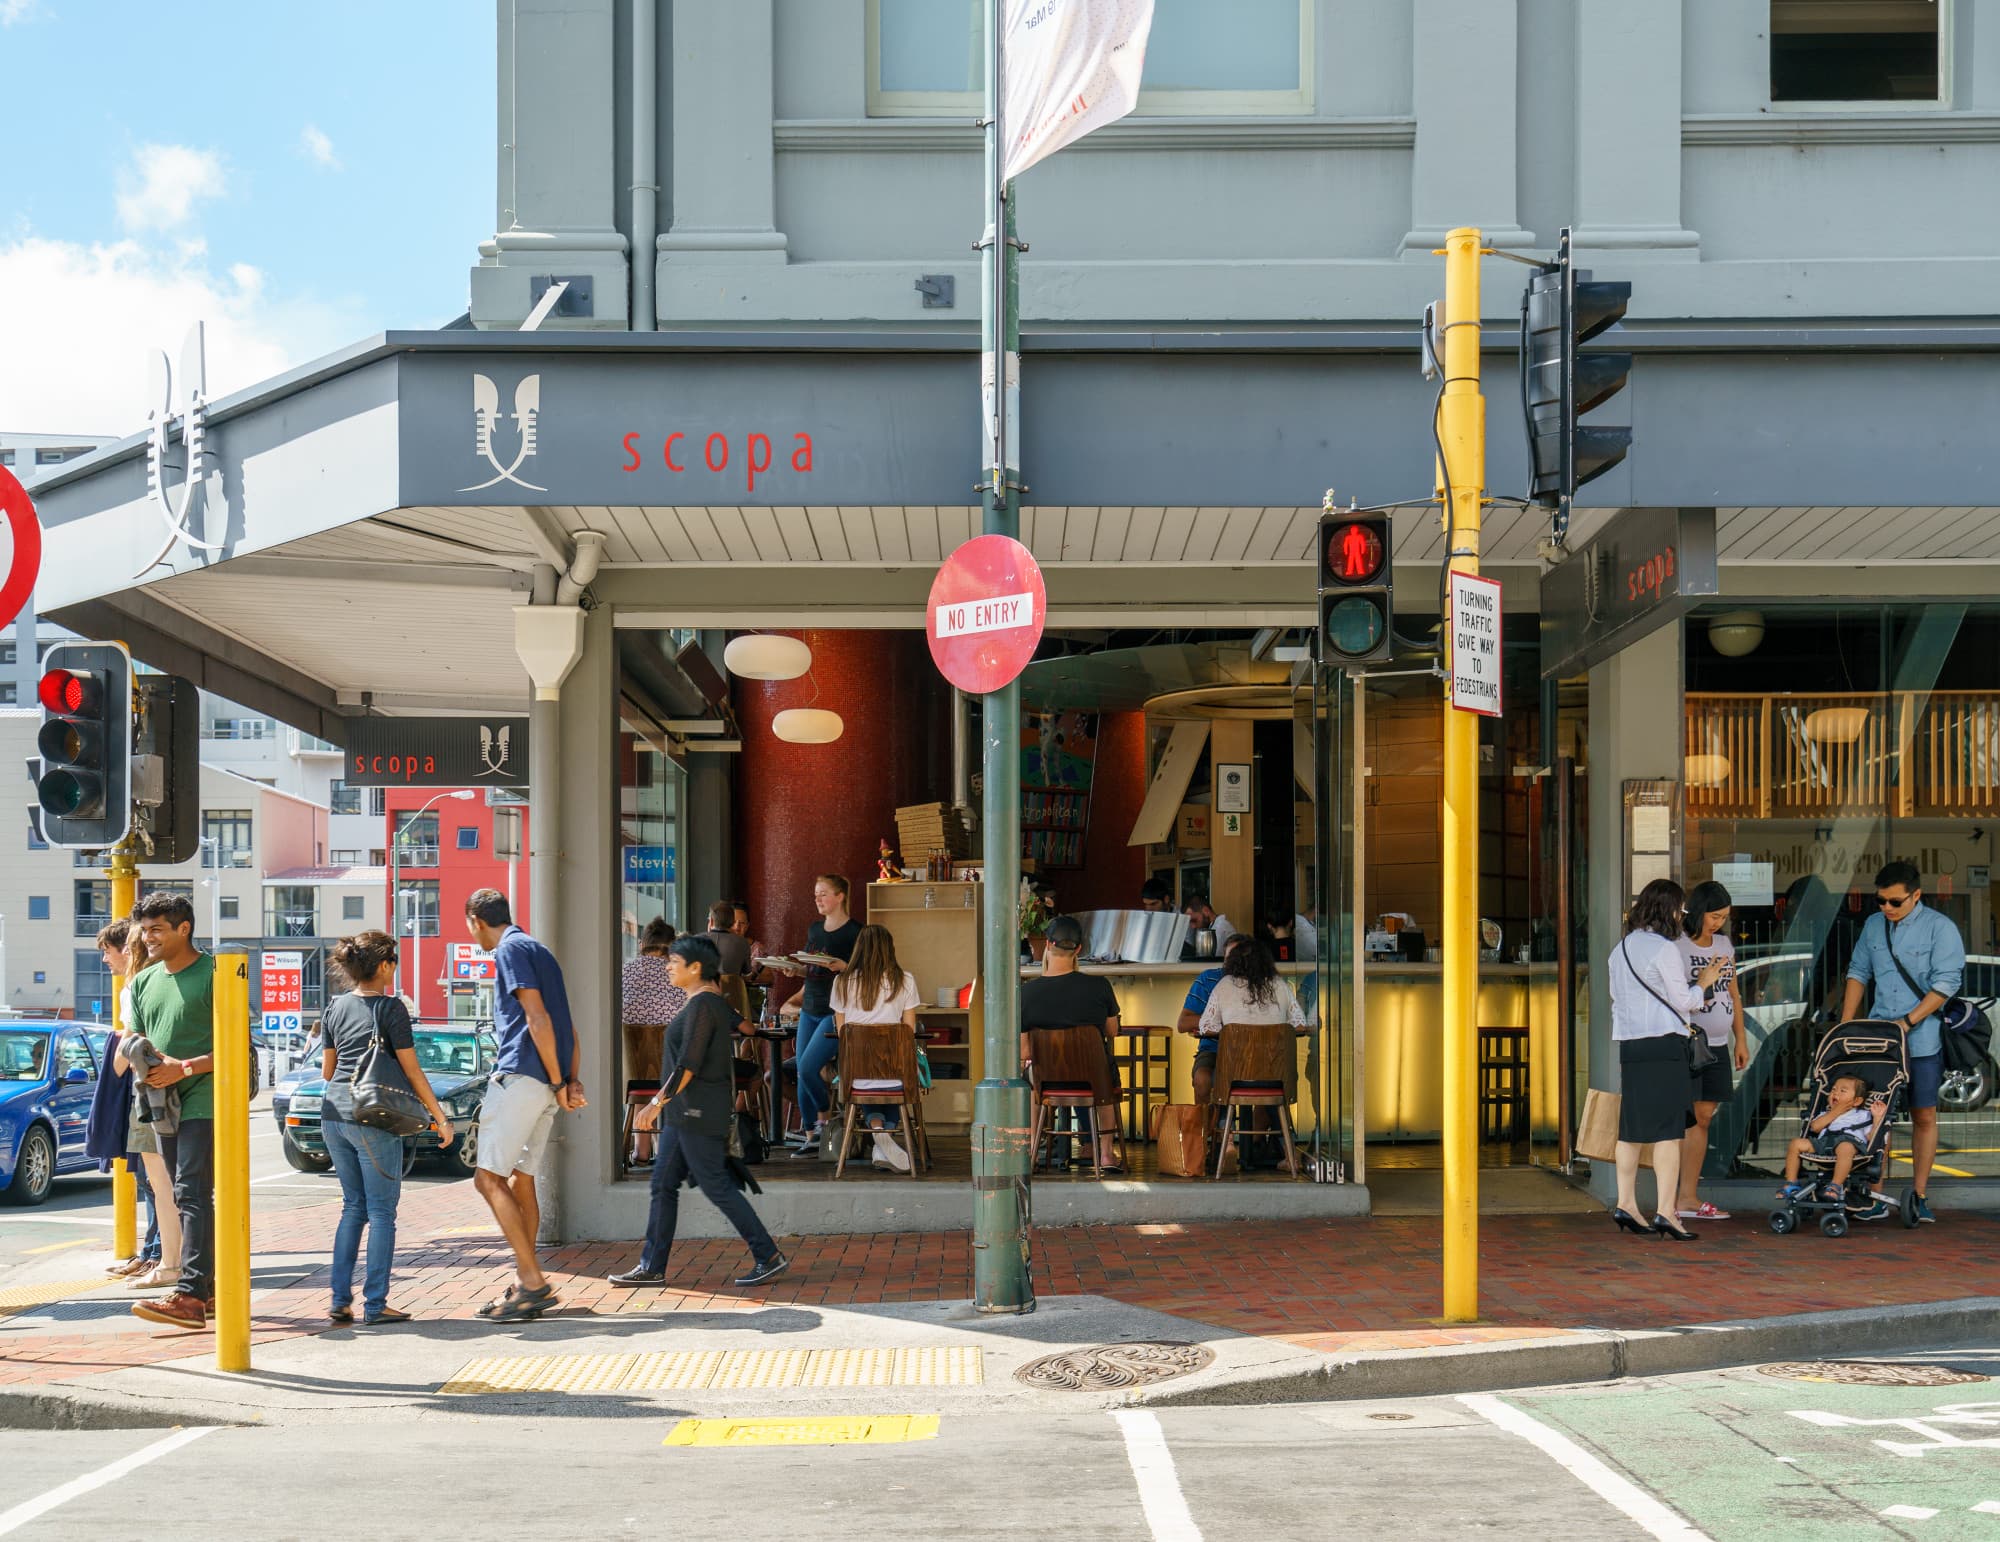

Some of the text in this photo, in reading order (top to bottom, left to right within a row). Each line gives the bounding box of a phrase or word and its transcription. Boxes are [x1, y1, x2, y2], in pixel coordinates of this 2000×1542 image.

[622, 431, 813, 492] scopa
[1628, 546, 1673, 601] scopa
[1459, 589, 1493, 612] TURNING
[948, 600, 1019, 631] NO ENTRY
[1460, 611, 1492, 633] TRAFFIC
[1458, 633, 1494, 655] GIVE WAY
[1472, 658, 1482, 674] TO
[1456, 676, 1498, 699] PEDESTRIANS
[355, 755, 435, 782] scopa
[629, 855, 676, 869] Steve's
[291, 974, 299, 986] 3
[279, 991, 299, 1002] $15
